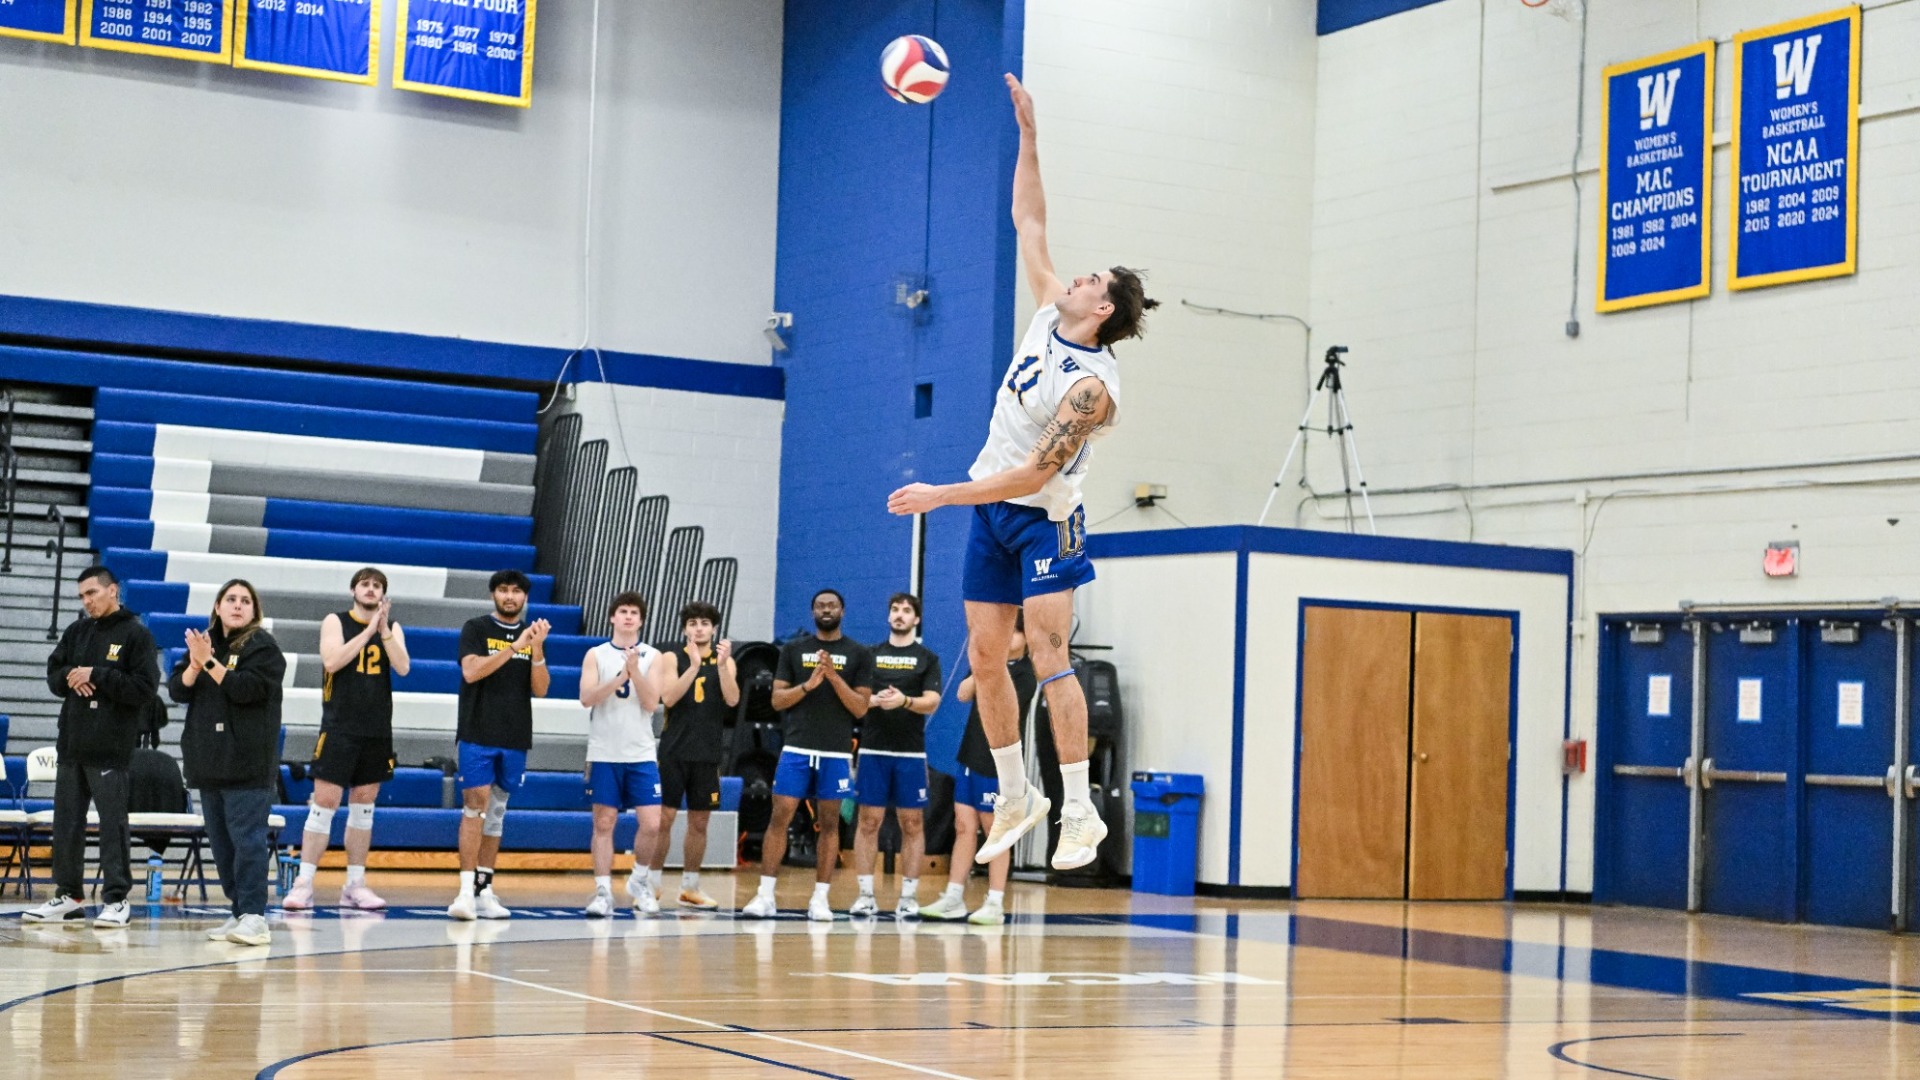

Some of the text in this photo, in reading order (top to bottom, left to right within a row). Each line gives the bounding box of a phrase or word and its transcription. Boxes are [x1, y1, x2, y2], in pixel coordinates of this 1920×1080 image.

[103, 6, 212, 31] 1988 1994 1995
[257, 0, 324, 16] 2012 2014
[100, 22, 213, 47] 2000 2001 2007
[416, 19, 516, 45] 1975 1977 1979
[415, 35, 443, 49] 1980
[486, 46, 516, 61] 2000
[1773, 34, 1822, 99] W
[1637, 68, 1681, 130] W
[1769, 101, 1818, 122] WOMEN'S
[1762, 115, 1826, 139] BASKETBALL
[1634, 131, 1677, 152] WOMEN'S
[1766, 137, 1819, 168] NCAA
[1626, 145, 1684, 168] BASKETBALL
[1636, 167, 1673, 194] MAC
[1742, 158, 1845, 194] TOURNAMENT
[1612, 187, 1695, 221] CHAMPIONS
[1746, 186, 1839, 215] 1982 2004 2009
[1670, 212, 1697, 230] 2004
[1744, 205, 1839, 233] 2013 2020 2024
[1640, 236, 1665, 253] 2024
[1034, 557, 1053, 576] W
[356, 644, 381, 675] 12
[876, 655, 918, 666] WIDENER
